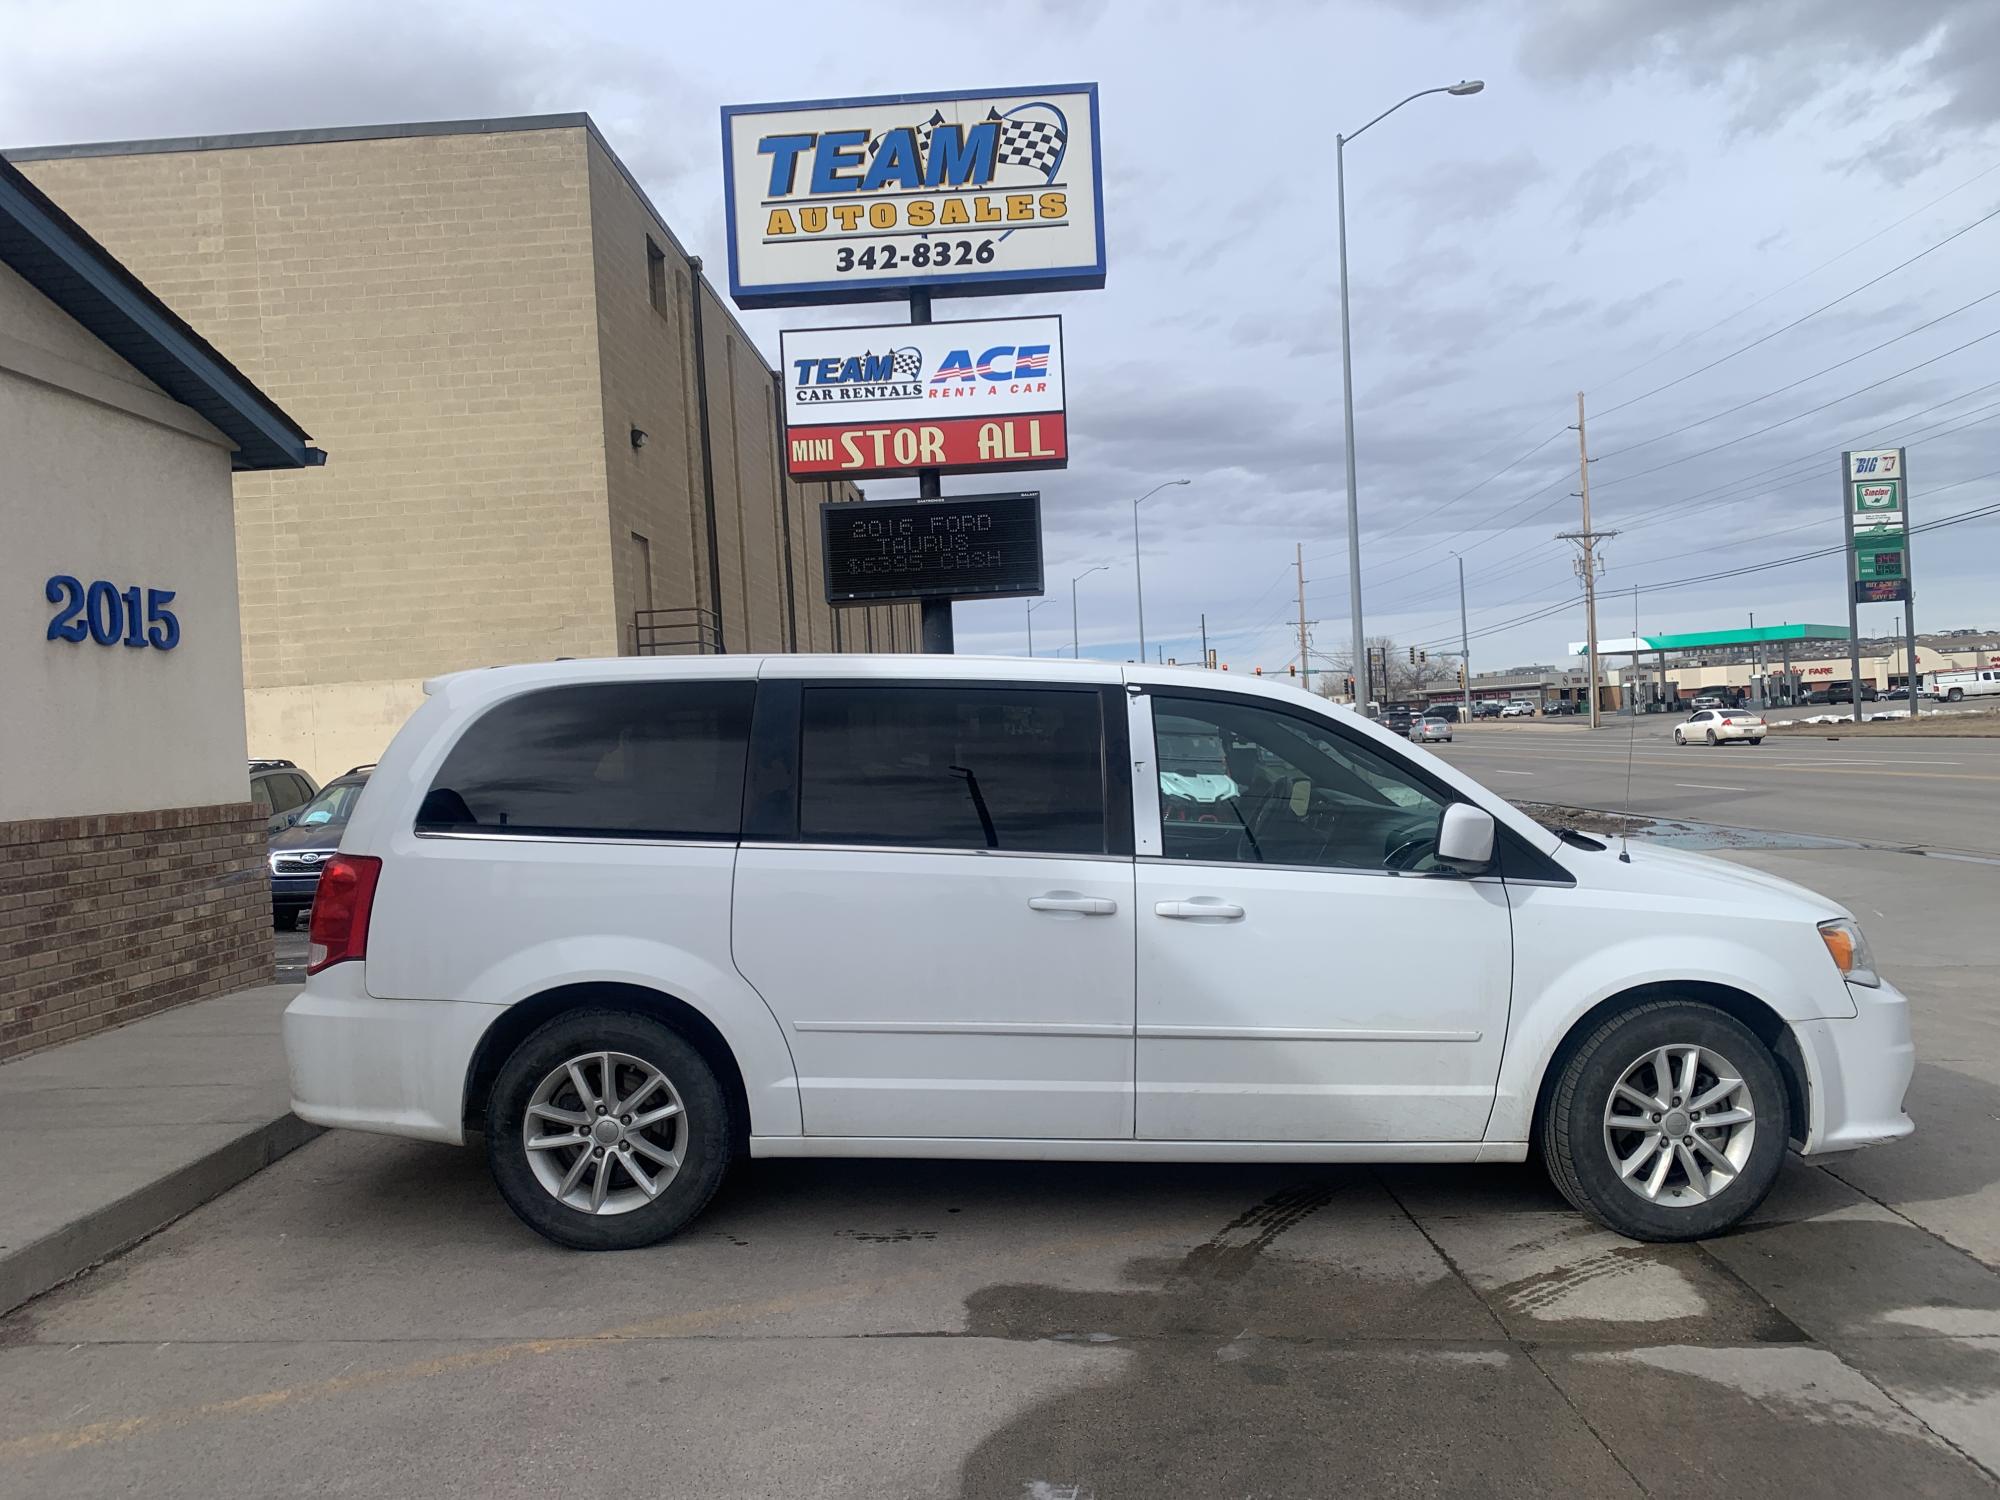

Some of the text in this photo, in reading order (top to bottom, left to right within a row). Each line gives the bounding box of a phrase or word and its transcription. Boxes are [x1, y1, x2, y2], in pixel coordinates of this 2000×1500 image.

[756, 120, 1003, 198] TEAM
[766, 193, 1067, 235] AUTO SALES
[836, 239, 995, 272] 342-8326
[794, 354, 897, 386] TEAM
[929, 344, 1051, 384] ACE
[796, 384, 923, 402] CAR RENTALS
[928, 382, 1047, 398] RENT A CAR
[792, 419, 1055, 468] MINI STOR ALL
[1856, 456, 1878, 473] BIG
[853, 514, 991, 538] 2016 FORD
[877, 534, 969, 554] TAURUS
[941, 550, 1001, 569] CASH
[46, 575, 180, 651] 2015
[1809, 667, 1833, 675] FARE
